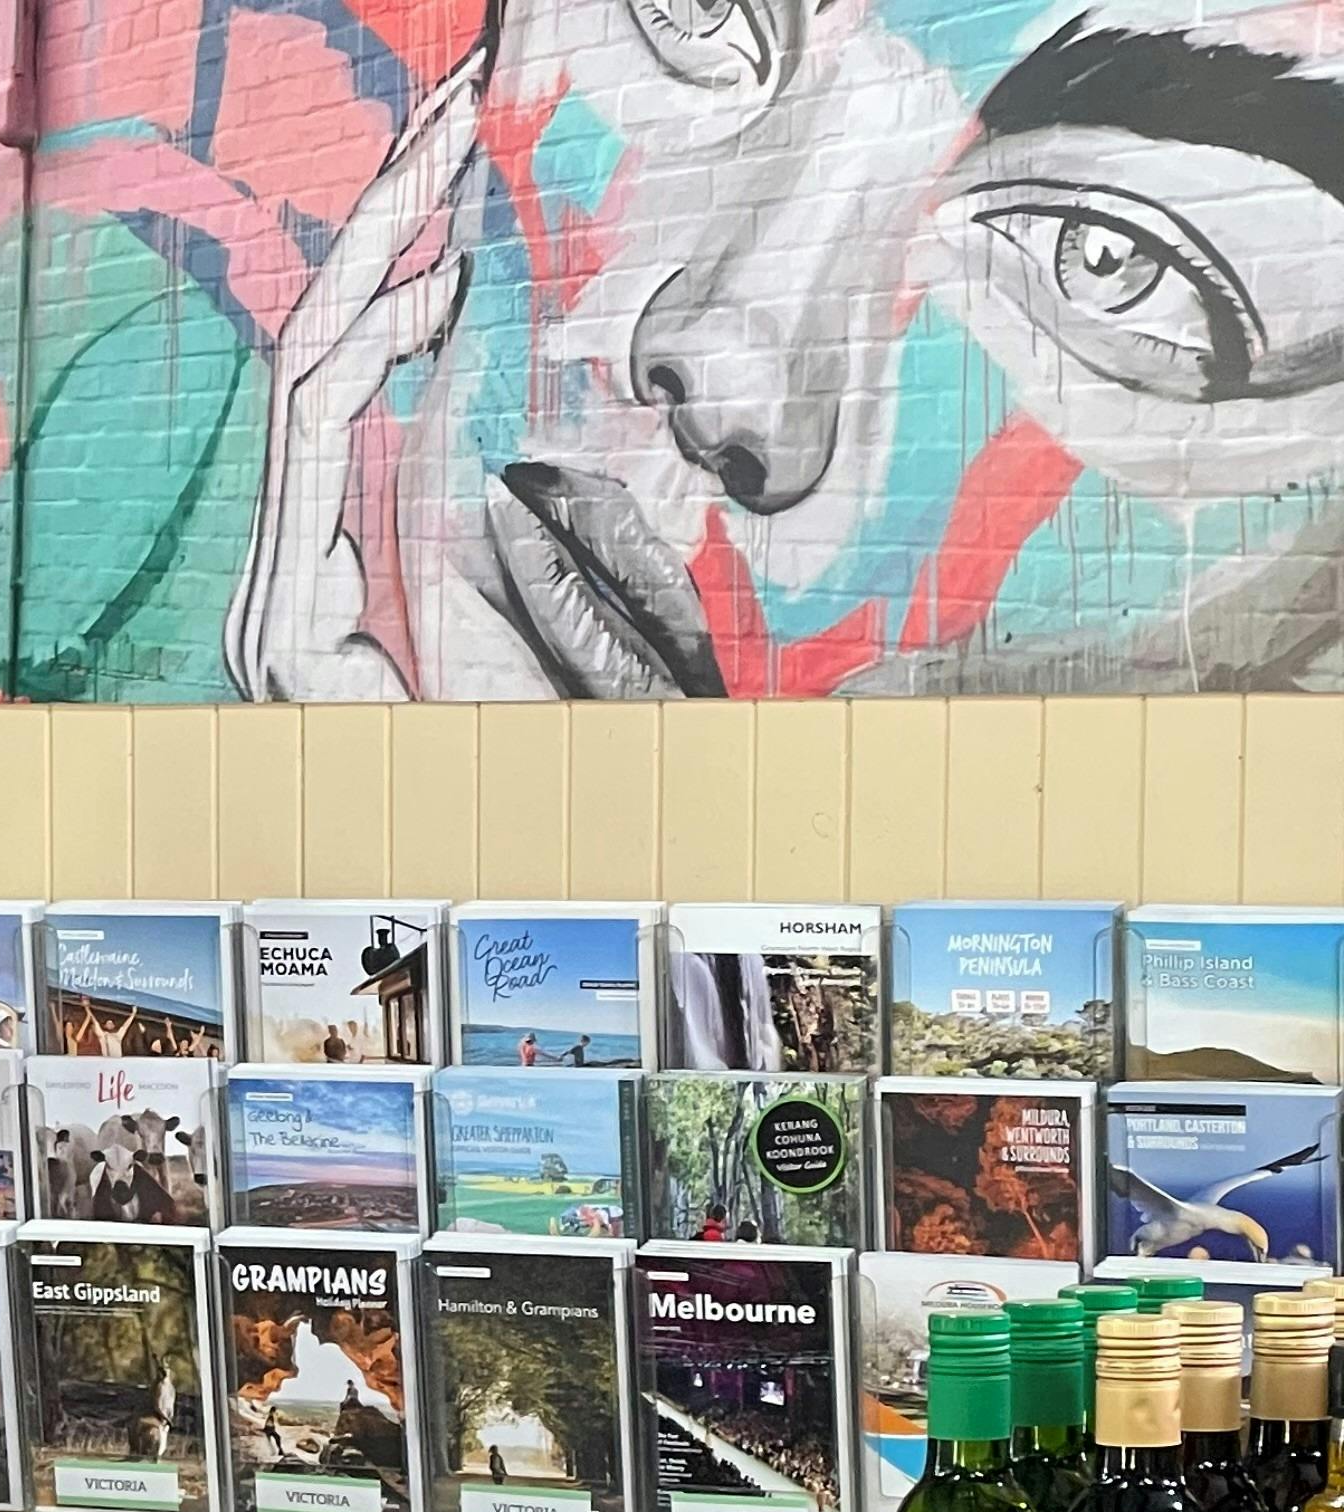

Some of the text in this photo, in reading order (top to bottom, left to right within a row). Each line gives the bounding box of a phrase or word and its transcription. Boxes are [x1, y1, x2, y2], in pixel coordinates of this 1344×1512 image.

[780, 921, 862, 935] HORSHAM
[473, 930, 534, 960] Great
[947, 933, 1053, 954] MORNINGTON
[259, 947, 333, 961] ECHUCA
[1142, 954, 1254, 972] Phillip Island
[260, 962, 328, 976] MOAMA
[959, 956, 1043, 977] PENINSULA
[1159, 973, 1255, 988] Bass Coast
[98, 1069, 137, 1109] Life
[774, 1118, 818, 1131] KERANG
[1021, 1109, 1070, 1128] MILDURA,
[250, 1130, 274, 1148] The
[774, 1133, 822, 1145] COHUNA
[1005, 1127, 1070, 1145] WENTWORTH
[766, 1146, 834, 1160] KOONDROOK
[232, 1263, 387, 1296] GRAMPIANS
[32, 1280, 161, 1306] East Gippsland
[437, 1298, 599, 1319] Hamilton & Grampians
[649, 1292, 816, 1325] Melbourne
[84, 1477, 148, 1493] VICTORIA
[286, 1490, 351, 1508] VICTORIA
